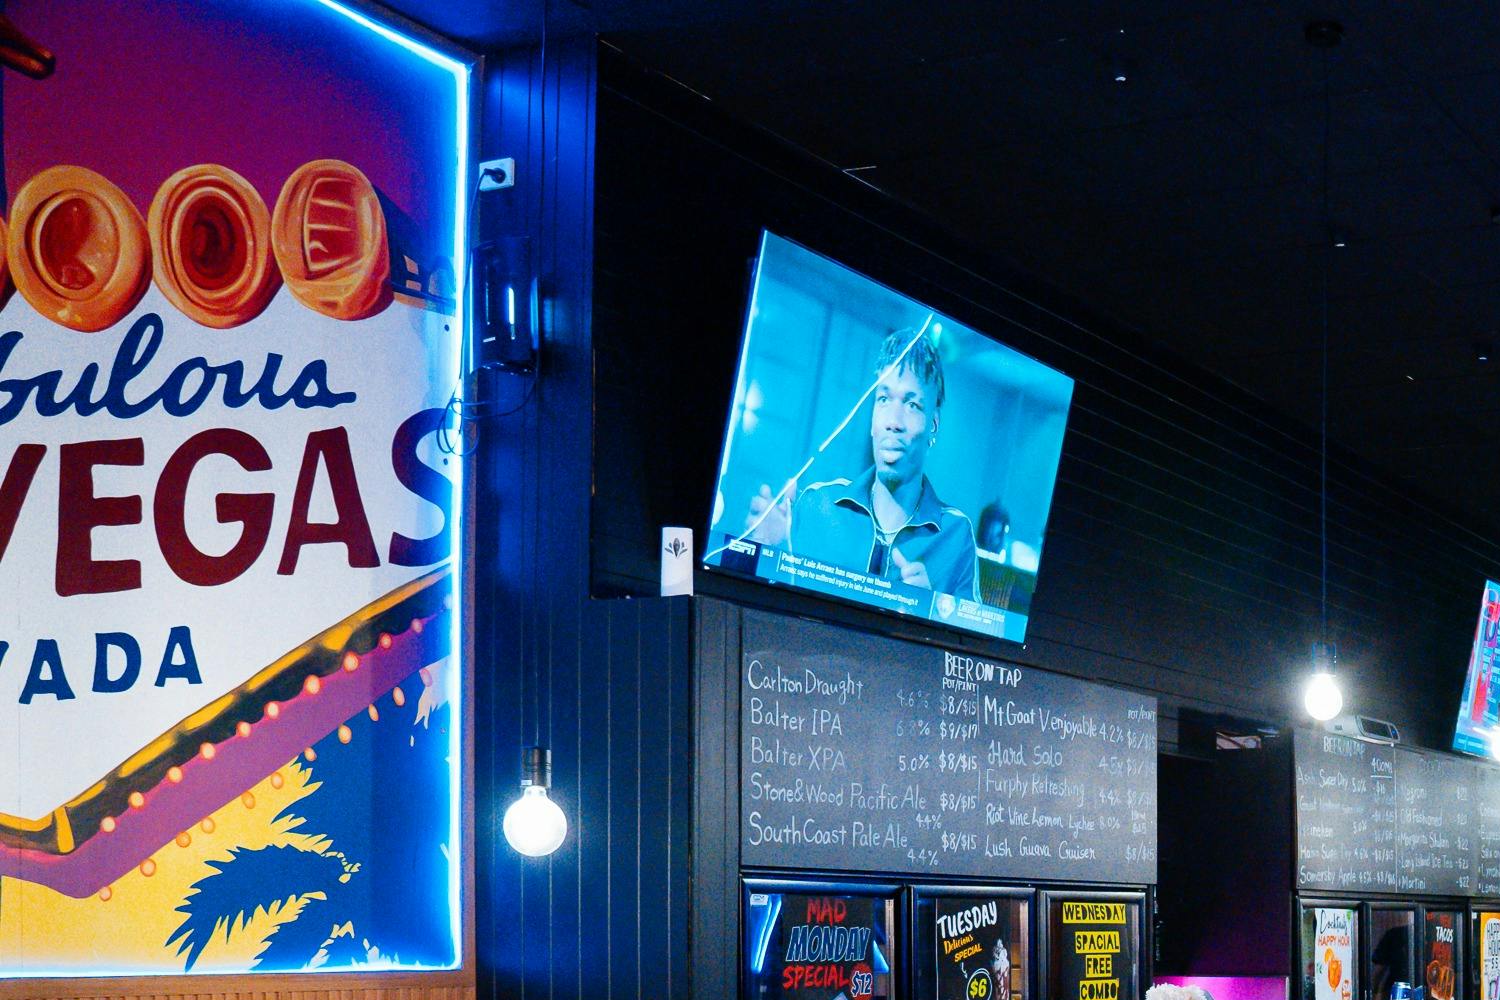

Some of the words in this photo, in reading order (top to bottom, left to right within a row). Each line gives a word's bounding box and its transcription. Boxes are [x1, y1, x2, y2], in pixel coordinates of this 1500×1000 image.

[804, 557, 816, 568] Luis
[0, 626, 203, 704] ADA
[944, 651, 974, 681] BEER
[975, 661, 994, 682] ON
[996, 665, 1022, 688] TAP
[748, 660, 803, 692] Carlton
[805, 669, 864, 705] Draught
[942, 677, 977, 693] POT/PINT
[750, 697, 805, 732] Balter
[811, 708, 843, 736] IPA
[939, 719, 978, 741] $9/$17
[1099, 722, 1124, 743] 4.2%
[751, 736, 803, 767] Balter
[808, 744, 846, 771] XPA
[899, 754, 930, 771] 5.0%
[938, 749, 978, 772] $8/$15
[987, 740, 1027, 768] Hard
[1032, 745, 1063, 768] Solo
[985, 768, 1028, 799] Furphy
[850, 782, 899, 811] Pacific
[901, 783, 927, 810] Ale
[939, 791, 977, 813] $8/$15
[986, 802, 1004, 826] Riot
[1031, 807, 1064, 829] Lemon
[749, 811, 801, 846] South
[803, 818, 848, 846] Coast
[852, 820, 881, 848] Pale
[882, 823, 908, 848] Ale
[941, 830, 977, 853] $8/$15
[985, 834, 1013, 859] Lush
[1019, 836, 1052, 858] Guava
[1058, 840, 1097, 860] Cruiser
[807, 897, 847, 926] MAD
[936, 900, 998, 939] TUESDAY
[1063, 903, 1125, 921] WEDNESDAY
[785, 925, 871, 962] MONDAY
[1076, 933, 1120, 951] SPACIAL
[1435, 926, 1454, 943] TACOS
[954, 943, 983, 963] SPECIAL
[1086, 957, 1111, 975] FREE
[783, 963, 850, 990] SPECIAL
[850, 971, 872, 997] $12
[969, 978, 988, 999] $6
[1080, 981, 1118, 1000] COMBO
